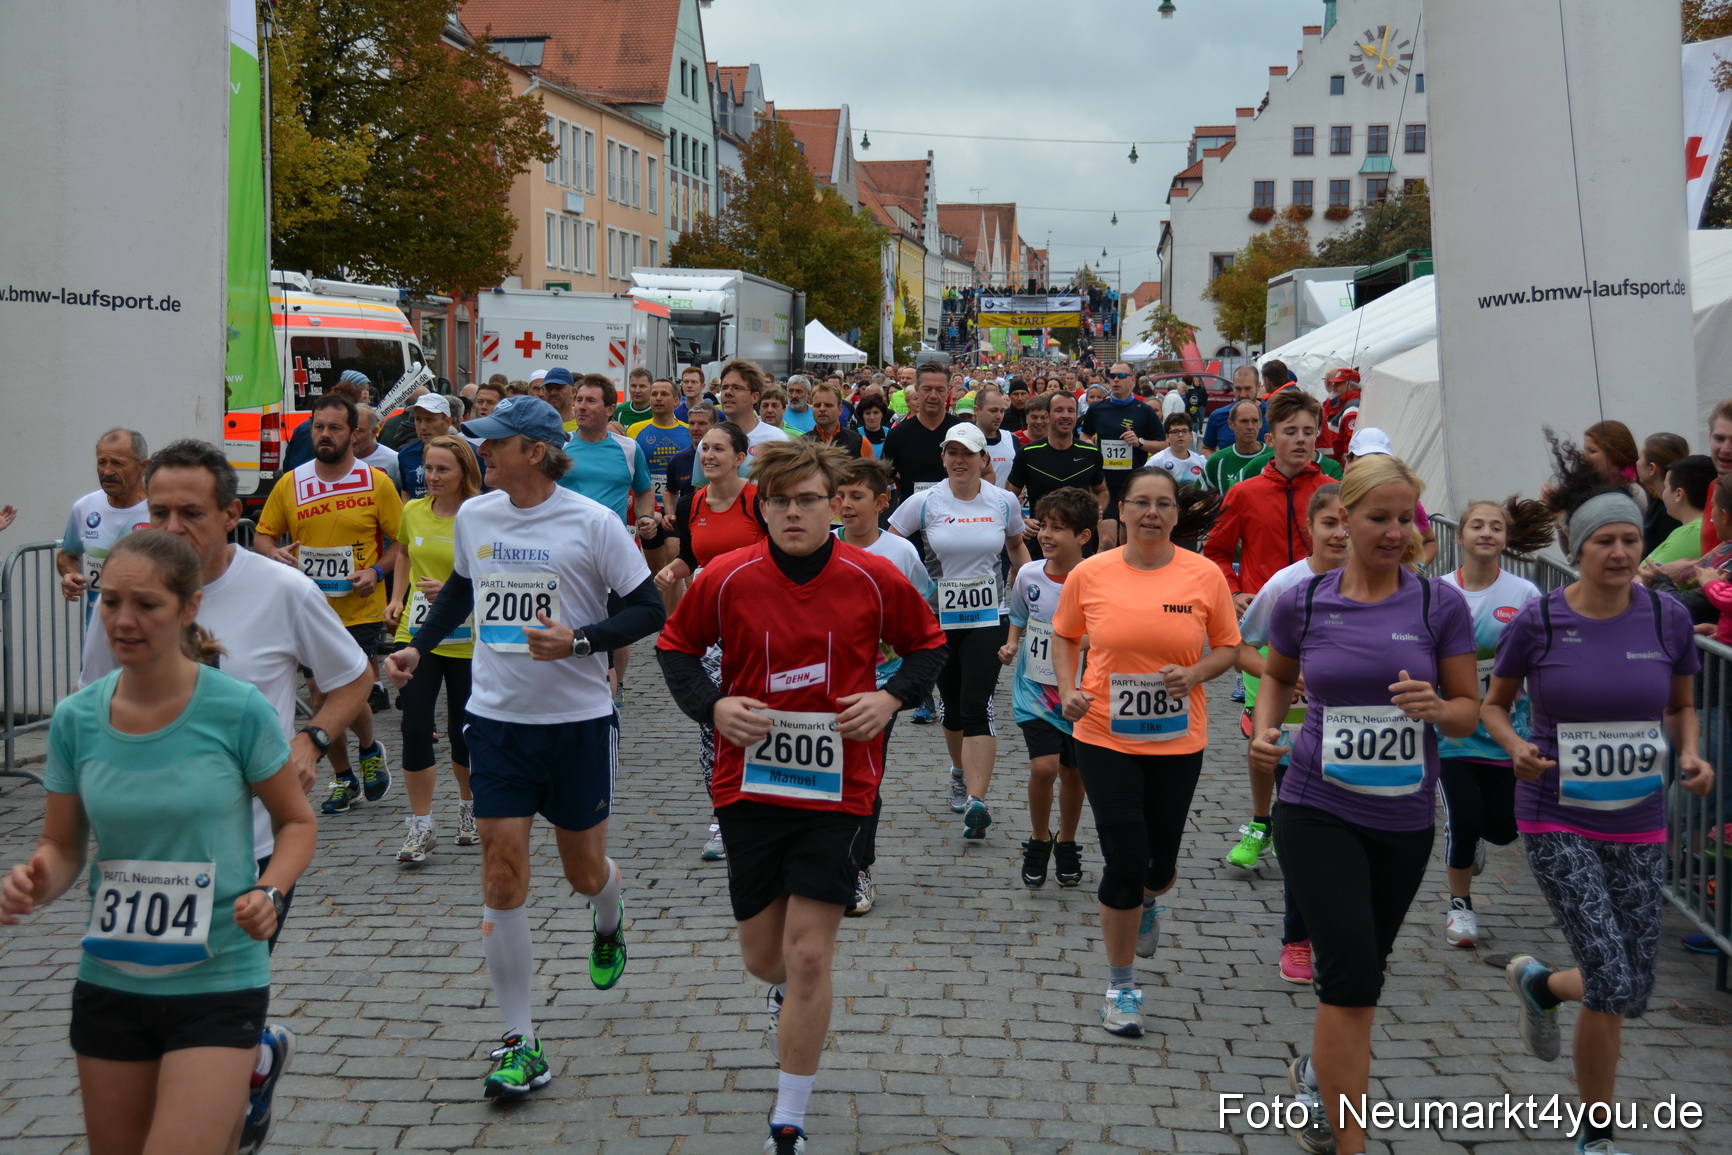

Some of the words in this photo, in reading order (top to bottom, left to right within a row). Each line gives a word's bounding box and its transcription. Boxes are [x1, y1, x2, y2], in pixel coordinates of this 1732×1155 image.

[1478, 278, 1686, 309] www.bmw-laufsport.de
[1011, 316, 1047, 325] START
[546, 332, 595, 342] Bayerisches
[545, 352, 568, 361] Kreuz
[380, 373, 429, 417] bmw-laufsport.de
[1106, 447, 1126, 458] 312
[297, 502, 332, 521] MAX
[336, 496, 375, 510] BÖGL
[492, 542, 550, 561] HÄRTEIS
[303, 559, 349, 577] 2704
[508, 581, 544, 589] Neumarkt
[959, 580, 986, 588] Neumarkt
[945, 587, 993, 609] 2400
[486, 592, 552, 621] 2008
[1163, 604, 1193, 614] THULE
[959, 612, 980, 621] Birgit
[1391, 633, 1418, 641] Kristina
[786, 672, 811, 685] DEHN
[780, 719, 825, 730] Neumarkt
[1326, 715, 1360, 723] PARTL
[1363, 715, 1408, 724] Neumarkt
[1140, 722, 1162, 732] Elke
[1561, 730, 1596, 740] PARTL
[1599, 730, 1645, 740] Neumarkt
[755, 732, 834, 768] 2606
[1334, 727, 1416, 761] 3020
[1571, 743, 1658, 777] 3009
[769, 769, 816, 786] Manuel
[133, 873, 189, 886] Neumarkt
[100, 888, 198, 937] 3104
